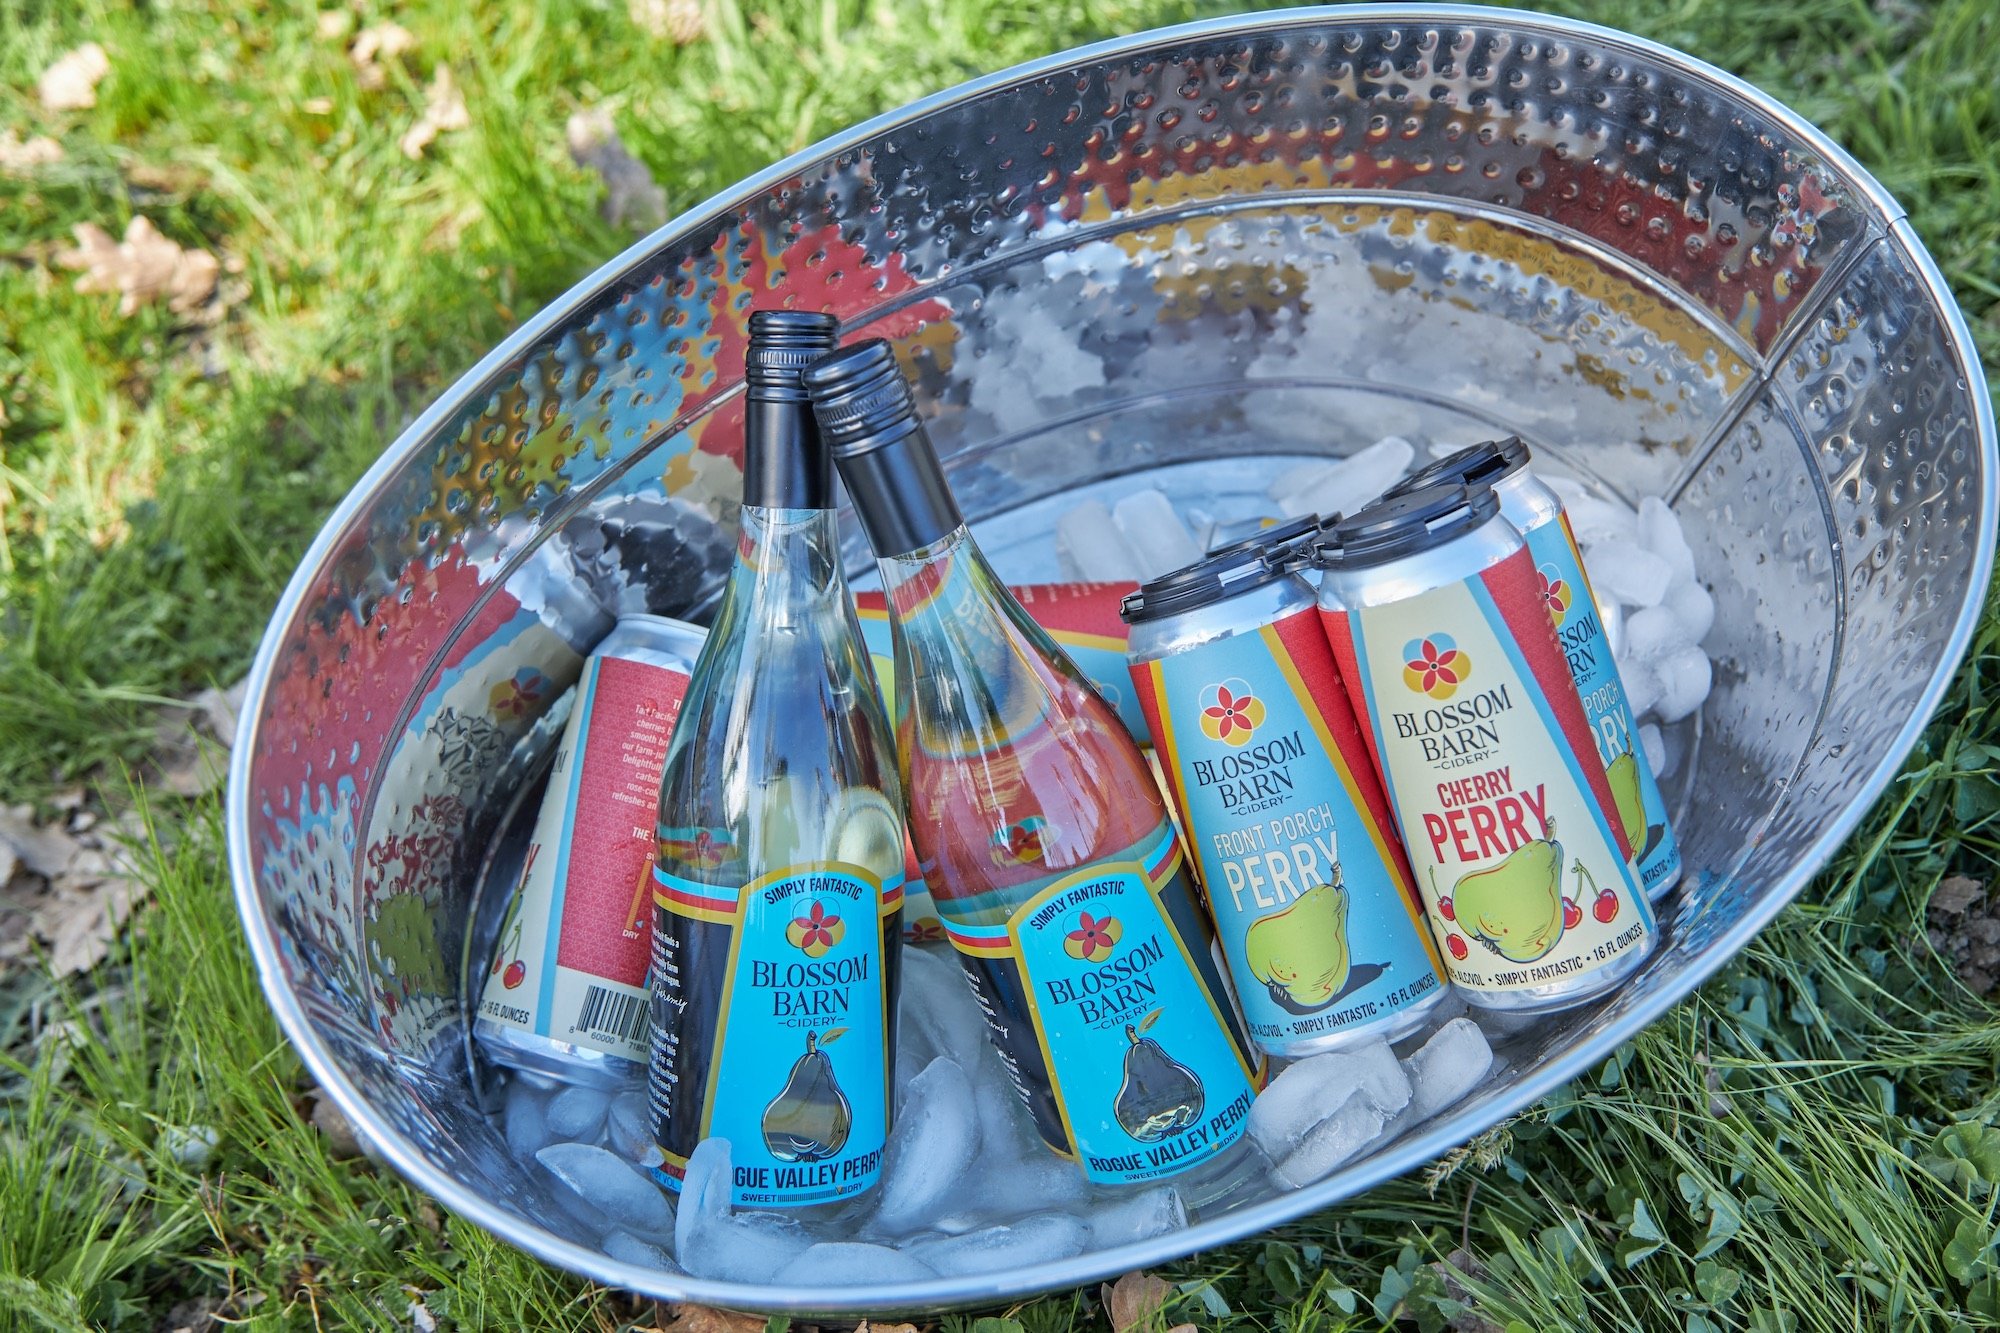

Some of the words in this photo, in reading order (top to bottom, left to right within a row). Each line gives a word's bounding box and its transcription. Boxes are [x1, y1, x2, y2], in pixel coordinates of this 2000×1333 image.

[636, 719, 666, 733] cherries
[1393, 684, 1513, 738] BLOSSOM
[622, 742, 634, 751] our
[630, 731, 657, 744] smooth
[1192, 730, 1306, 787] BLOSSOM
[1420, 720, 1500, 762] BARN
[612, 792, 646, 807] refreshes
[1218, 766, 1294, 809] BARN
[1436, 765, 1513, 809] CHERRY
[632, 826, 650, 841] THE
[1213, 824, 1267, 859] FRONT
[1270, 802, 1336, 846] PORCH
[1422, 783, 1548, 864] PERRY
[764, 879, 806, 905] SIMPLY
[810, 878, 863, 901] FANTASTIC
[1221, 830, 1345, 913] PERRY
[1030, 897, 1068, 931] SIMPLY
[1067, 881, 1125, 906] FANTASTIC
[622, 929, 640, 941] DRY
[1495, 970, 1528, 987] SIMPLY
[1531, 956, 1583, 982] FANTASTIC
[1593, 945, 1606, 961] 16
[1607, 942, 1618, 956] FL
[1617, 922, 1644, 949] OUNCES
[751, 953, 868, 989] BLOSSOM
[1045, 934, 1164, 1005] BLOSSOM
[500, 1005, 531, 1025] OUNCES
[773, 987, 850, 1017] BARN
[1078, 972, 1156, 1024] BARN
[1292, 1016, 1325, 1036] SIMPLY
[1327, 1001, 1377, 1026] FANTASTIC
[1386, 992, 1400, 1008] 16
[1399, 987, 1411, 1002] FL
[1410, 972, 1435, 997] OUNCES
[590, 1033, 616, 1045] 60000
[1088, 1152, 1147, 1173] ROGUE
[1145, 1125, 1210, 1168] VALLEY
[1210, 1089, 1251, 1138] PERRY
[731, 1166, 769, 1189] GUE
[774, 1162, 840, 1189] VALLEY
[843, 1149, 883, 1182] PERRY
[1124, 1170, 1159, 1181] SWEET
[1224, 1129, 1239, 1146] DRY
[741, 1193, 777, 1203] SWEET
[847, 1181, 863, 1194] DRY
